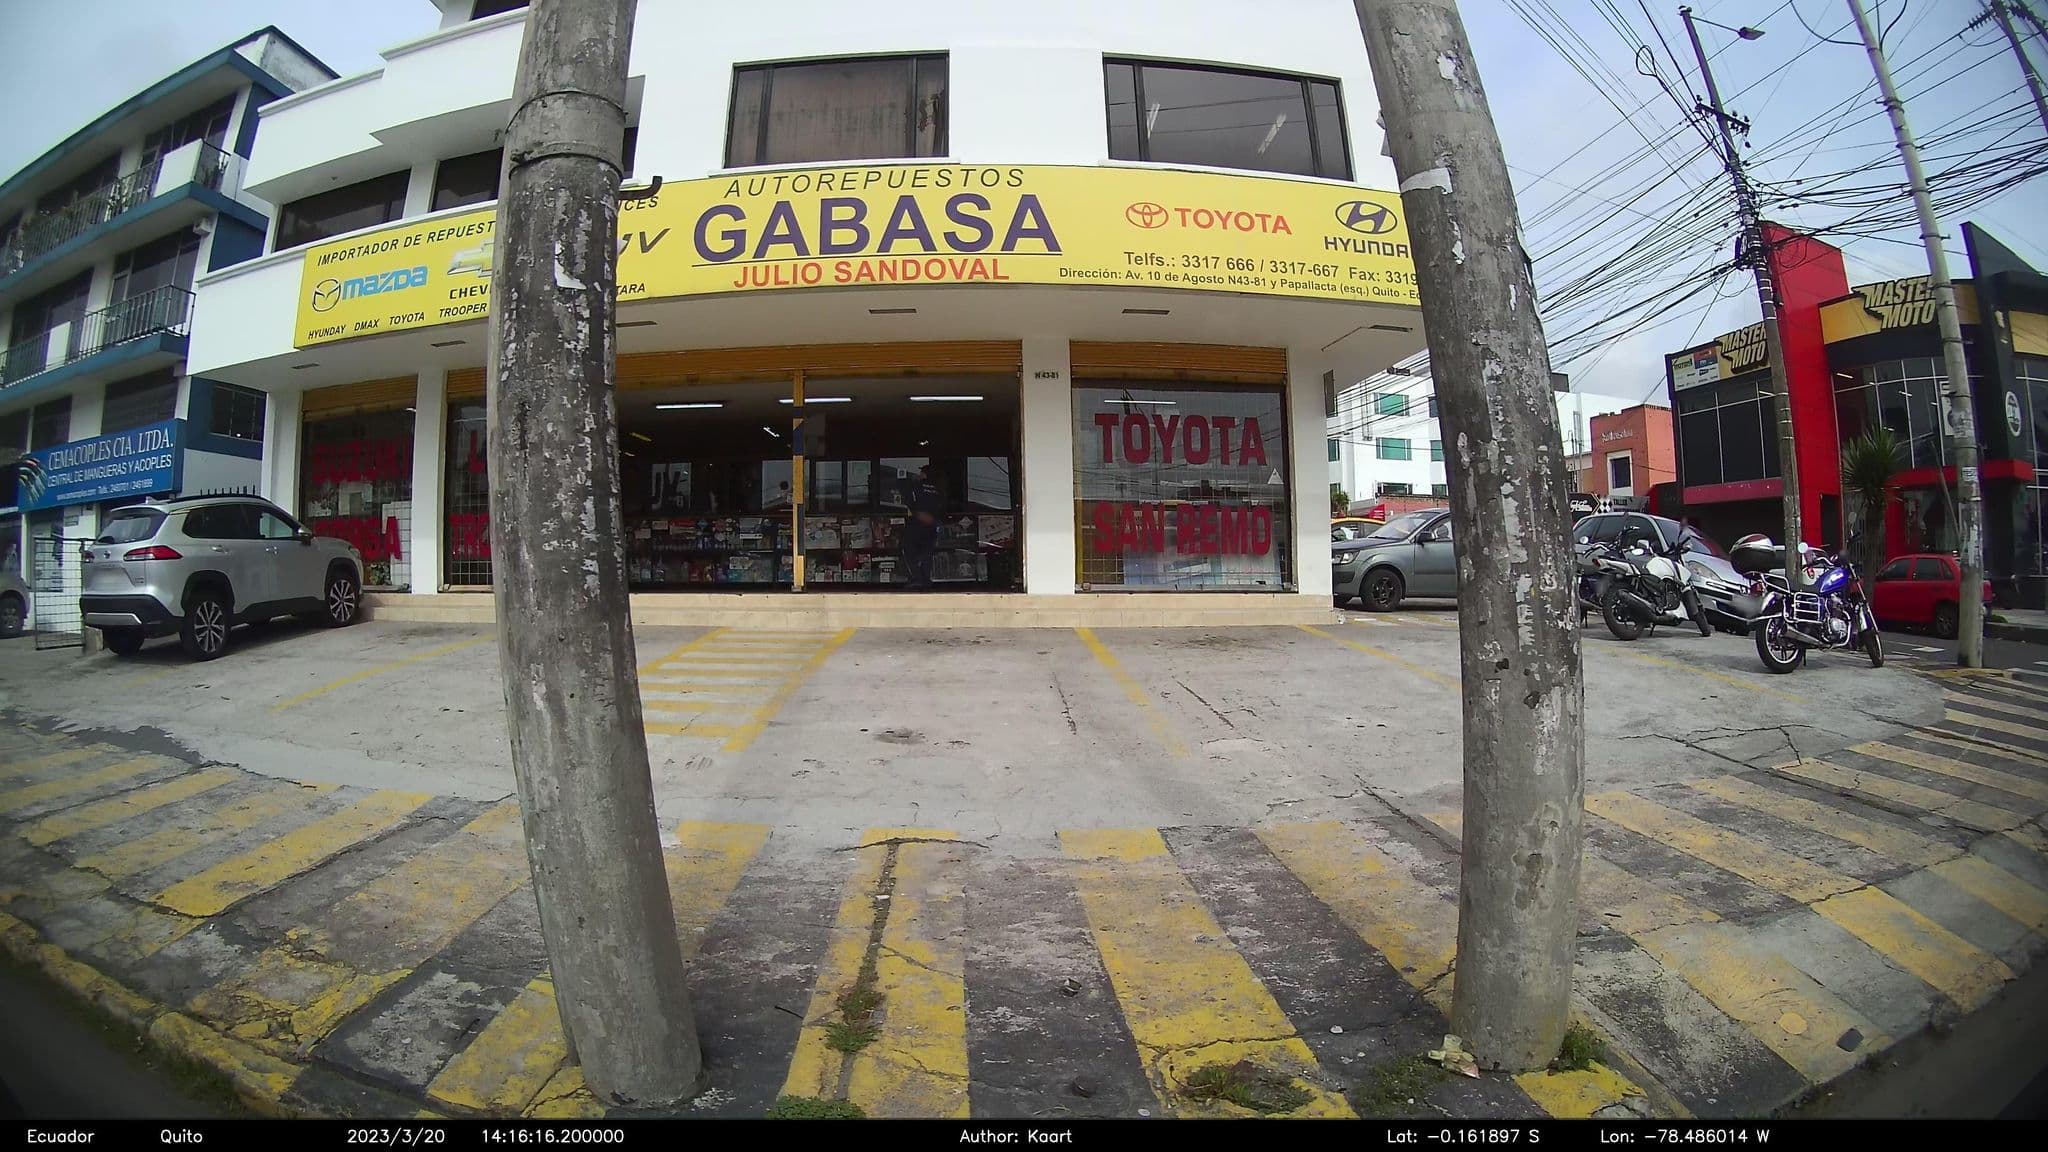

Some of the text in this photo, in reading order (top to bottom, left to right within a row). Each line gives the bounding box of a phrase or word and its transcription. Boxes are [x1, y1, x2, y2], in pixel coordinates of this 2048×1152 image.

[724, 168, 1025, 199] AUTOREPUESTOS
[693, 193, 1062, 262] GABASA
[1174, 207, 1293, 235] TOYOTA
[318, 238, 399, 266] IMPORTADOR
[404, 234, 422, 248] DE
[426, 220, 496, 244] REPUEST
[1324, 236, 1410, 259] HYUNDA
[733, 258, 1010, 289] JULIO SANDOVAL
[1124, 251, 1175, 268] Telfs.:
[1182, 254, 1220, 270] 3317
[1226, 257, 1255, 272] 666
[1260, 259, 1265, 272] /
[1269, 260, 1339, 278] 3317-667
[1349, 266, 1381, 282] Fax:
[450, 284, 490, 300] CHEV
[1059, 267, 1122, 280] Dirección:
[1125, 270, 1144, 281] Av.
[1148, 271, 1161, 281] 10
[1165, 272, 1179, 282] de
[1182, 273, 1225, 286] Agosto
[1228, 275, 1266, 287] N43-81
[1271, 279, 1277, 289] y
[1280, 279, 1337, 293] Papallacta
[1340, 284, 1369, 297] (esq.)
[1372, 286, 1400, 298] Quito
[308, 303, 487, 340] HYUNDAY DMAX TOYOTA TROOPER
[1868, 299, 1937, 329] MOTO
[1723, 341, 1766, 369] MOTO
[48, 427, 174, 471] CEMACOPLES CIA. LTDA.
[1094, 413, 1268, 466] TOYOTA
[84, 461, 127, 481] MANGUERAS
[127, 460, 135, 473] Y
[134, 454, 172, 472] ACOPLES
[1093, 500, 1272, 557] SAN REMO
